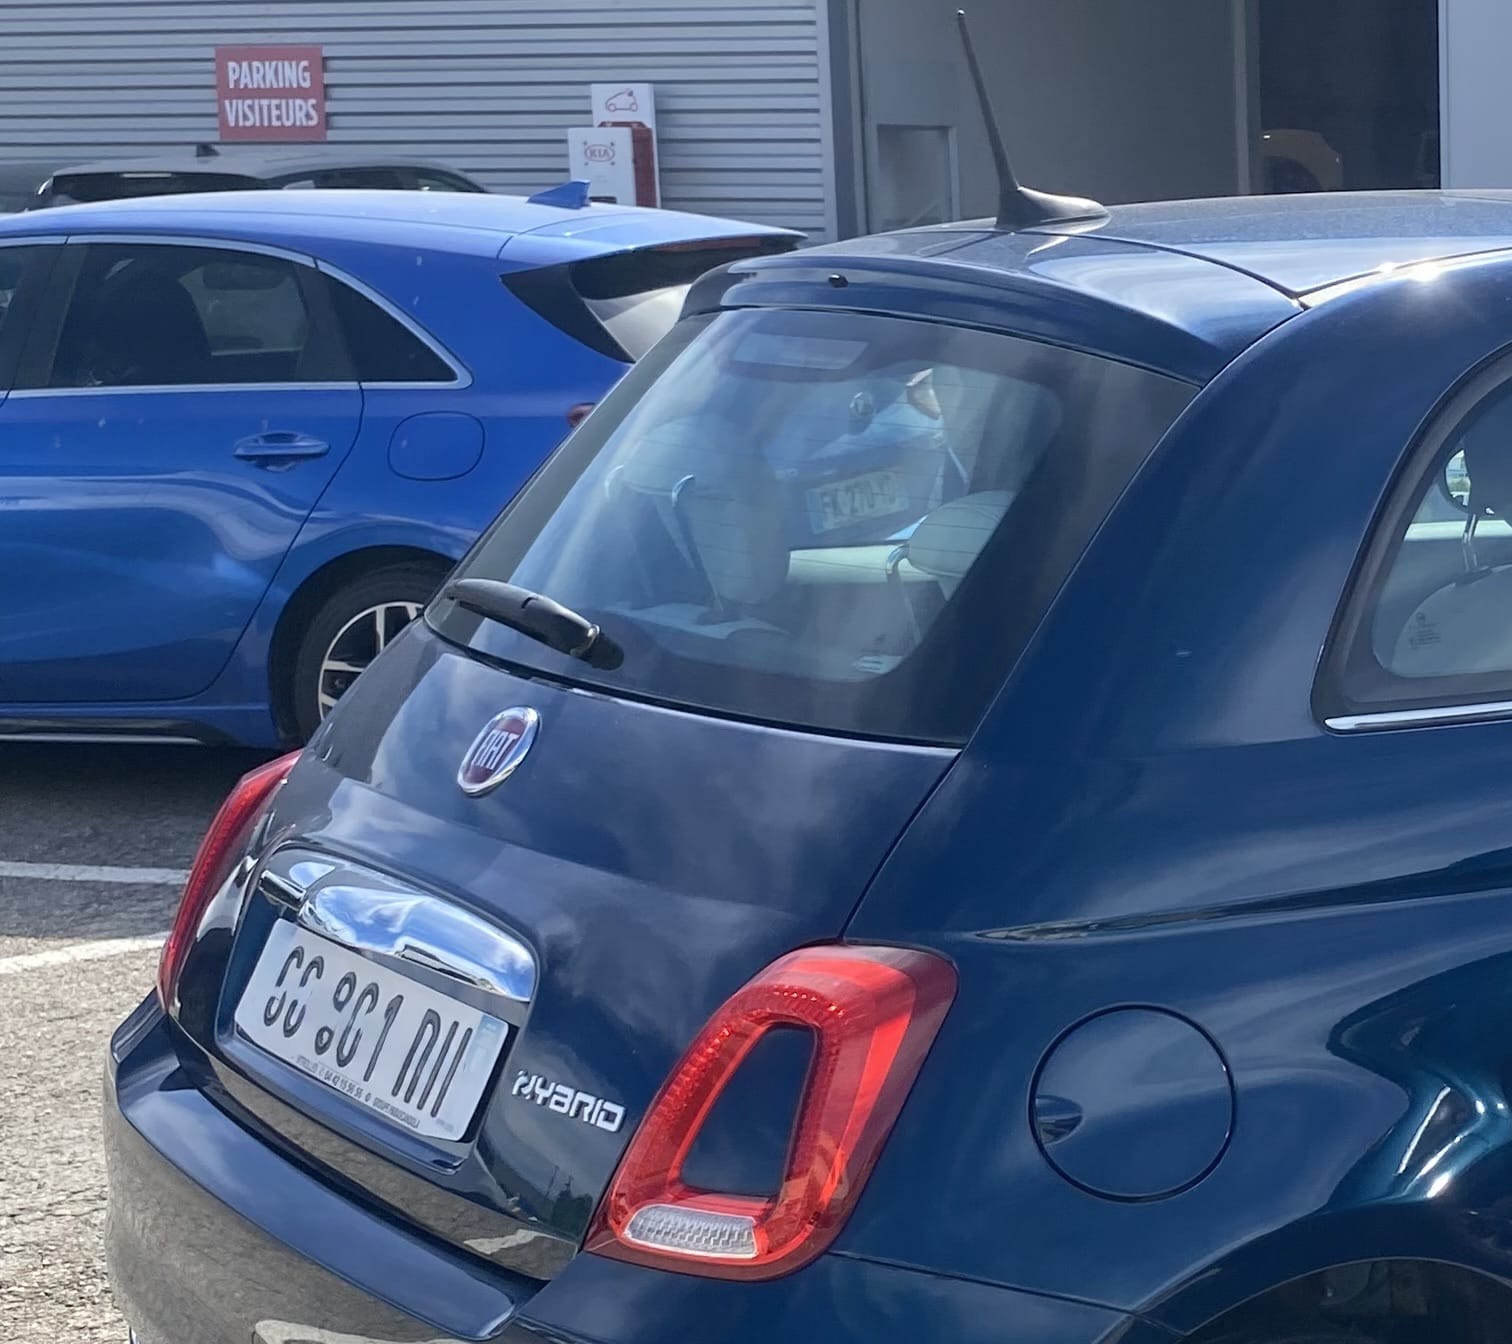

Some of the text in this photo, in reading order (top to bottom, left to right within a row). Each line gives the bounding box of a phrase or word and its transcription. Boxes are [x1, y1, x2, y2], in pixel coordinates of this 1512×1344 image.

[227, 60, 311, 89] PARKING
[224, 97, 319, 129] VISITEURS
[470, 729, 521, 771] FIAT
[512, 1070, 626, 1133] HYBRID
